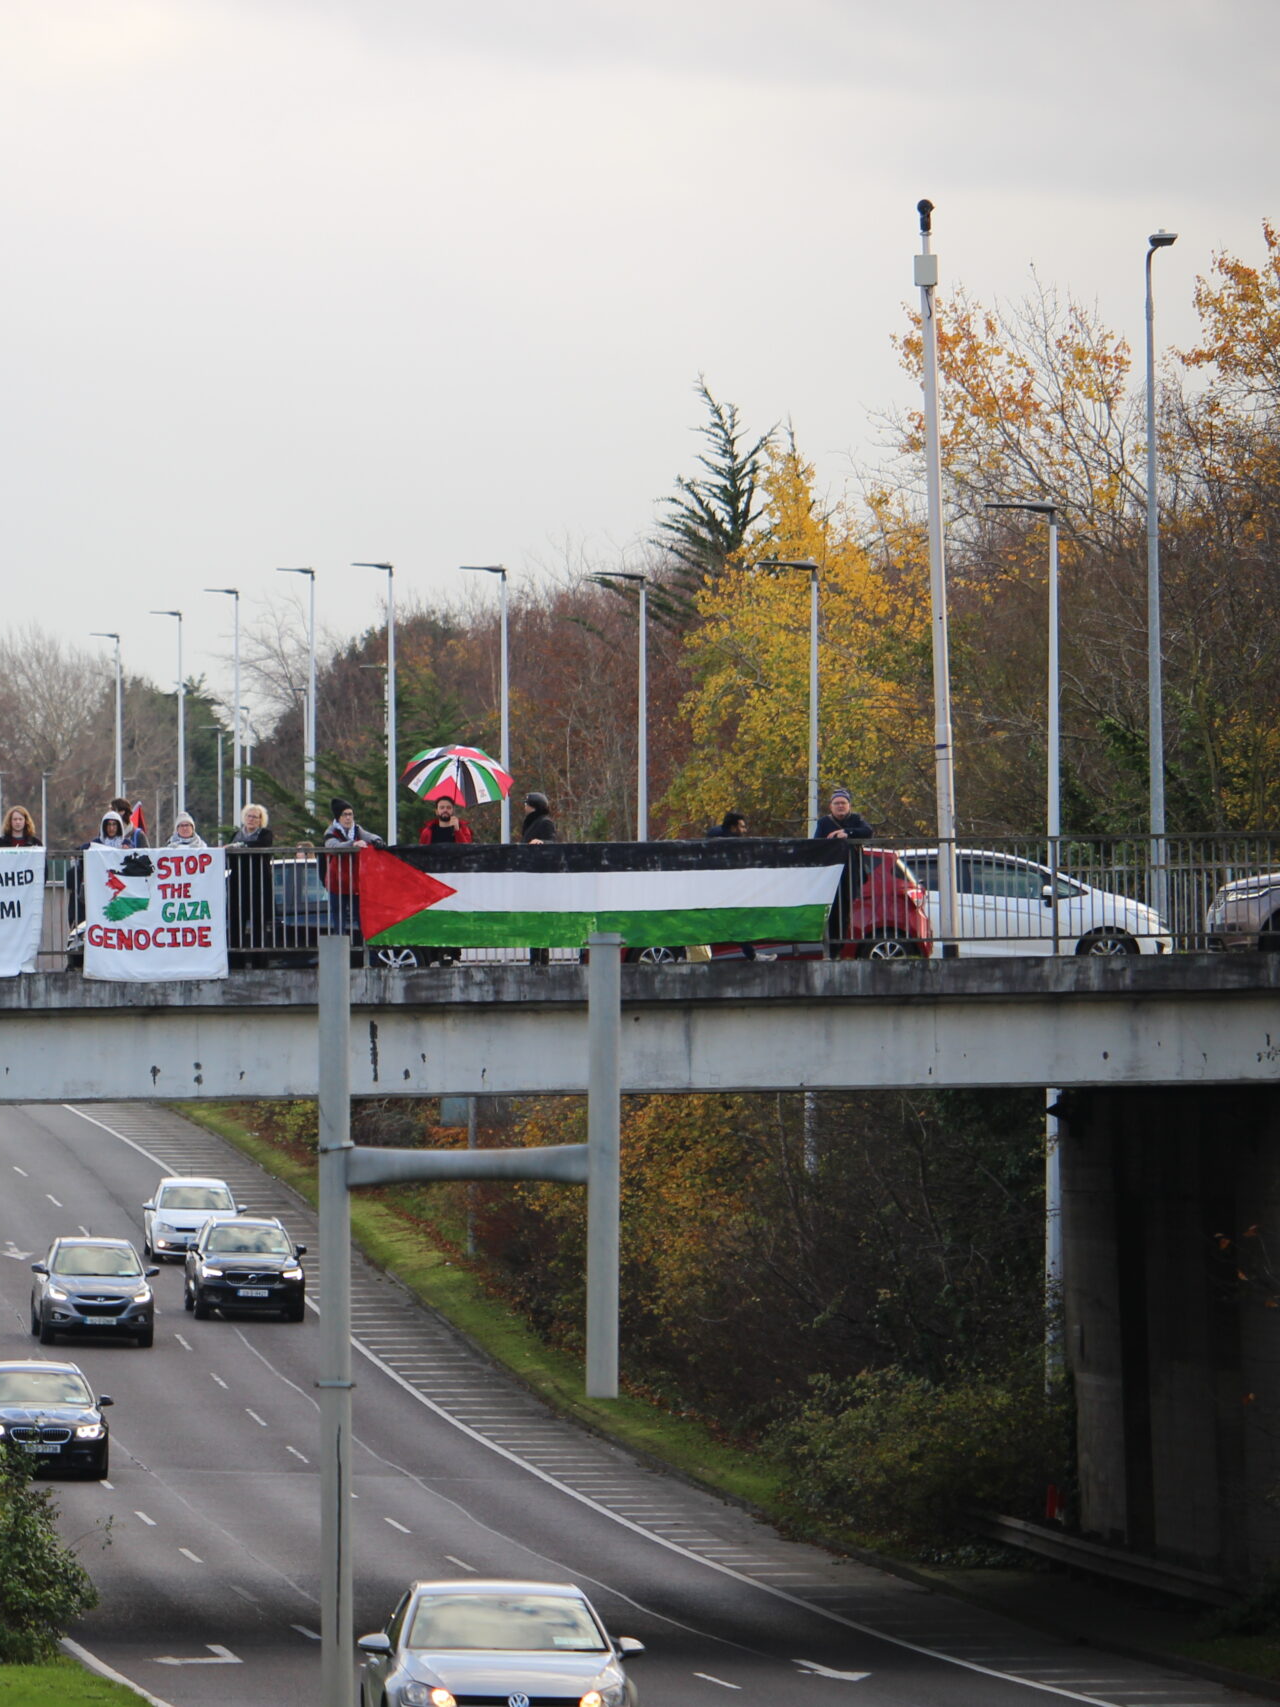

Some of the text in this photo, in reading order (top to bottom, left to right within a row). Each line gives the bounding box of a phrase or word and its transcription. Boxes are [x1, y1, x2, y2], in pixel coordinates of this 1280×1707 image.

[157, 853, 212, 880] STOP
[157, 882, 192, 900] THE
[161, 900, 212, 923] GAZA
[87, 924, 212, 951] GENOCIDE
